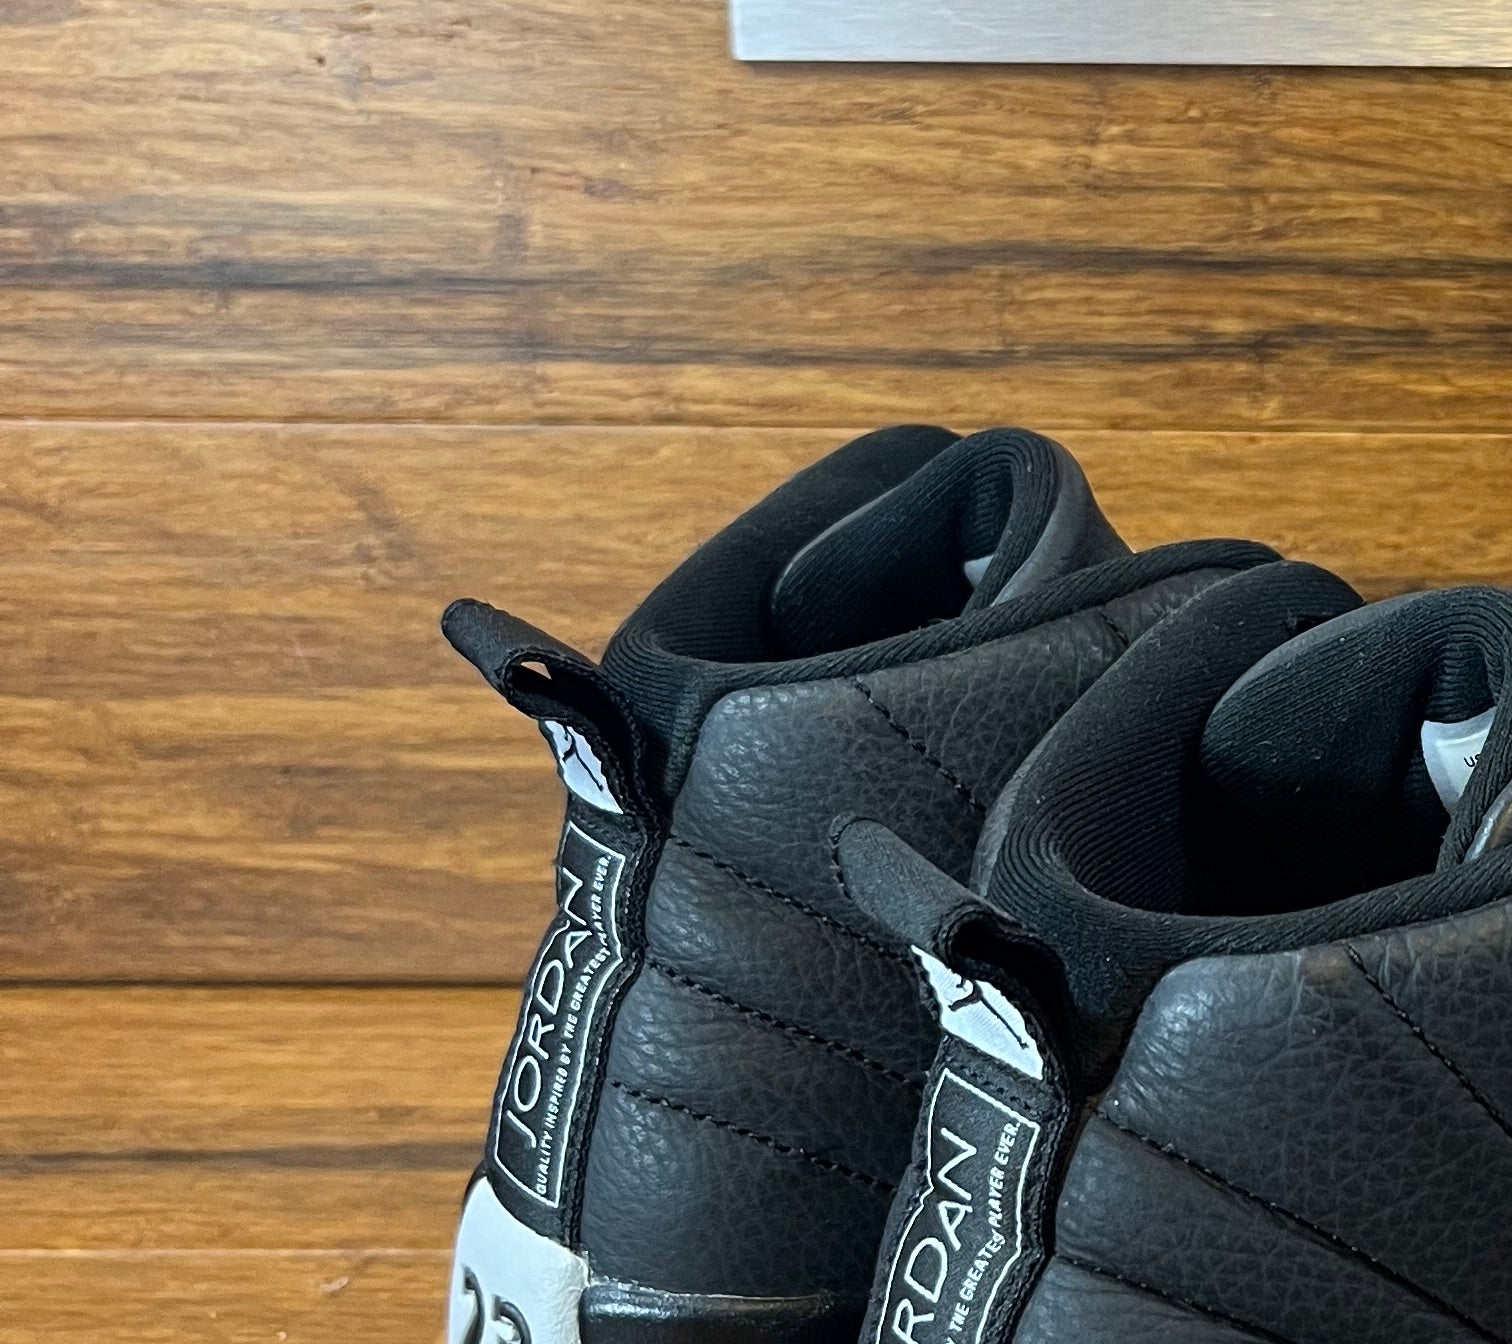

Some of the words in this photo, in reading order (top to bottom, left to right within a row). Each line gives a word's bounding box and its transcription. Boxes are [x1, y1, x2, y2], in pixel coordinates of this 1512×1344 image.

[506, 866, 593, 1149] JORDAN
[569, 947, 612, 1011] GREATEST
[559, 1042, 573, 1066] BY
[563, 1012, 578, 1039] THE
[544, 1066, 569, 1129] INSPIRED
[535, 1130, 553, 1195] QUALITY
[949, 1301, 970, 1332] THE
[987, 1166, 1005, 1228] PLAYER
